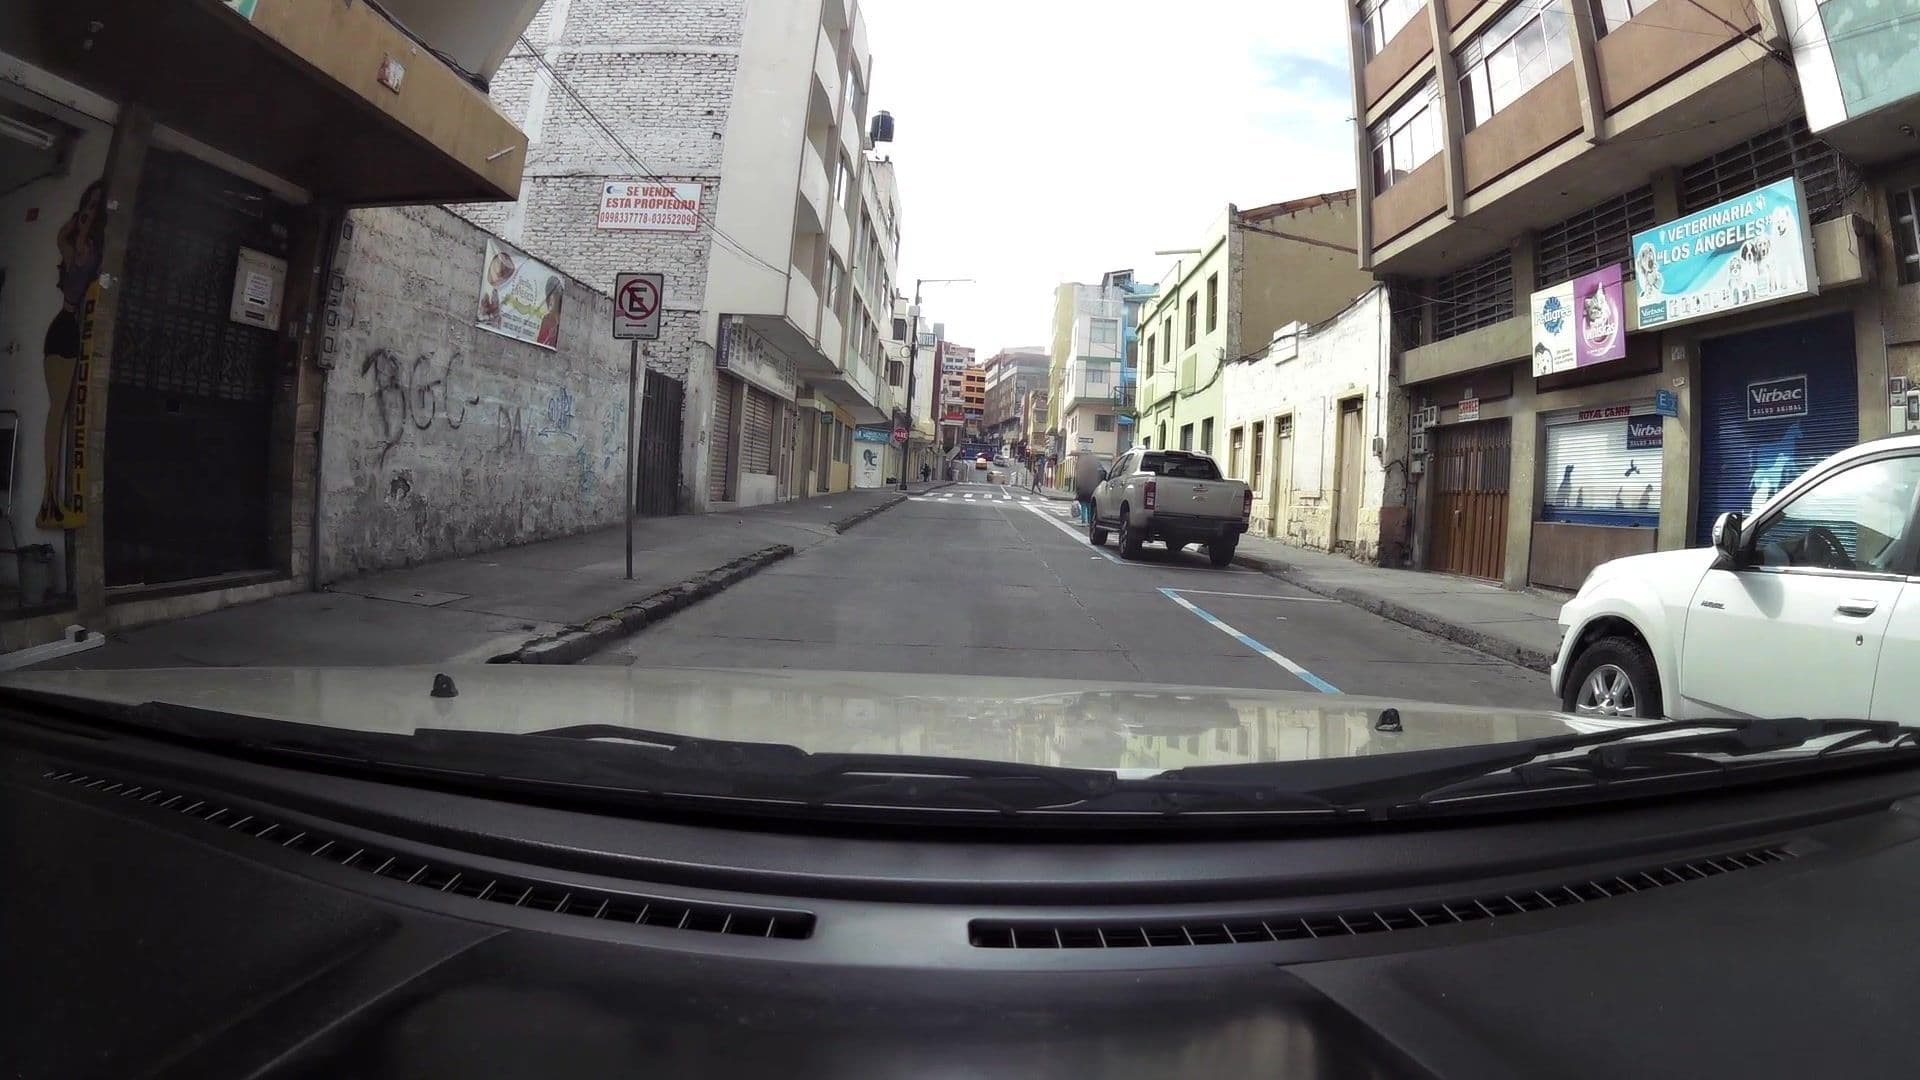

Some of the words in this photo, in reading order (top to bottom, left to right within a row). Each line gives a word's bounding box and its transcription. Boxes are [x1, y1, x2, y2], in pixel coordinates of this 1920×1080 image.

[626, 186, 640, 196] SE
[642, 186, 676, 197] VENDE
[606, 197, 632, 209] ESTA
[634, 199, 696, 210] PROPIEDAD
[1667, 201, 1756, 243] VETERINARIA
[1535, 304, 1572, 326] Pedigree
[1641, 307, 1665, 318] Virbac
[1750, 387, 1802, 404] Virbac
[1578, 408, 1603, 421] ROYAL
[894, 430, 908, 440] PARE
[1629, 423, 1663, 437] Virba
